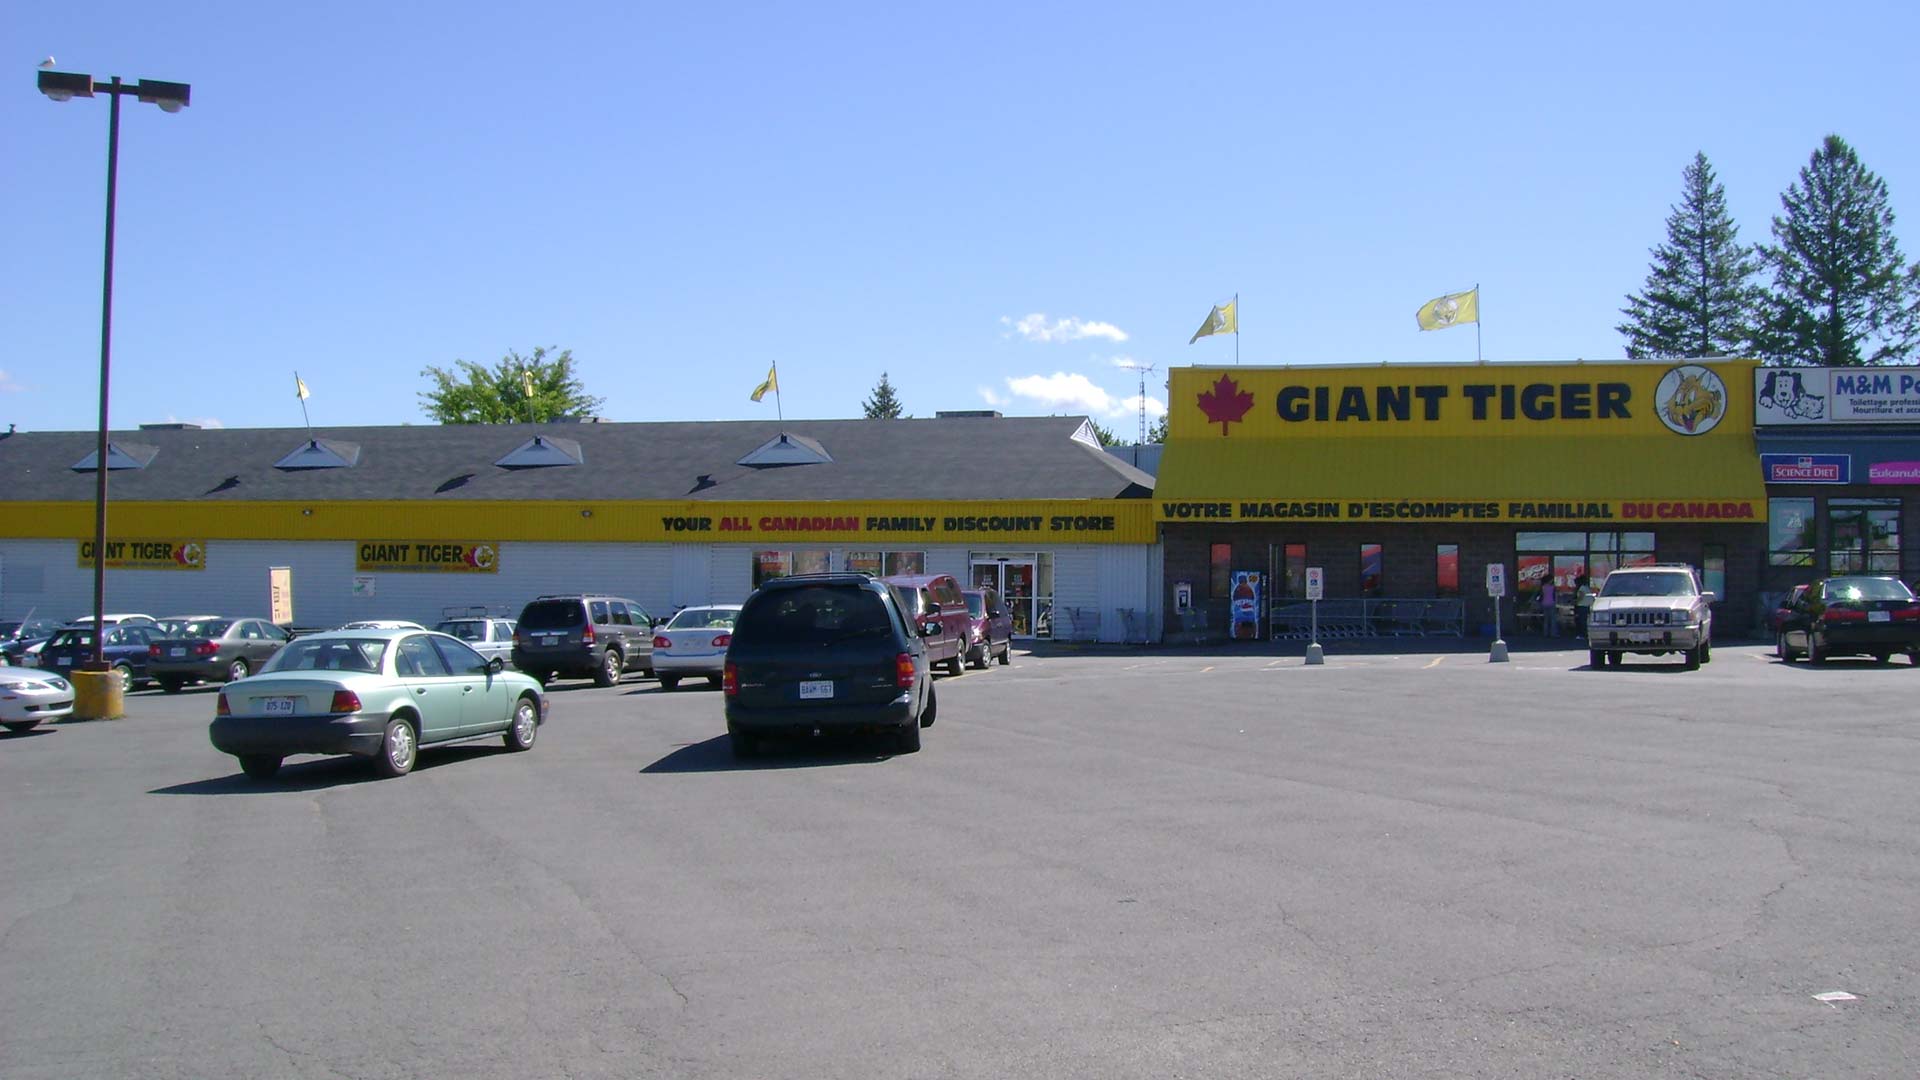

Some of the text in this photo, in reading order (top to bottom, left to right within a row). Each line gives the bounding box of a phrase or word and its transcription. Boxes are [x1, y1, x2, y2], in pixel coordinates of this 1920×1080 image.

[1836, 375, 1892, 395] M&M
[1276, 383, 1632, 422] GIANT TIGER
[1775, 467, 1834, 477] SCIENCE DIET
[1162, 502, 1754, 518] VOTRE MAGASIN D'ESCOMPTES FAMILIAL DU CANADA
[662, 516, 1115, 531] YOUR ALL CANADIAN FAMILY DISCOUNT STORE
[81, 542, 172, 559] GINT TIGER
[361, 544, 463, 562] GIANT TIGER
